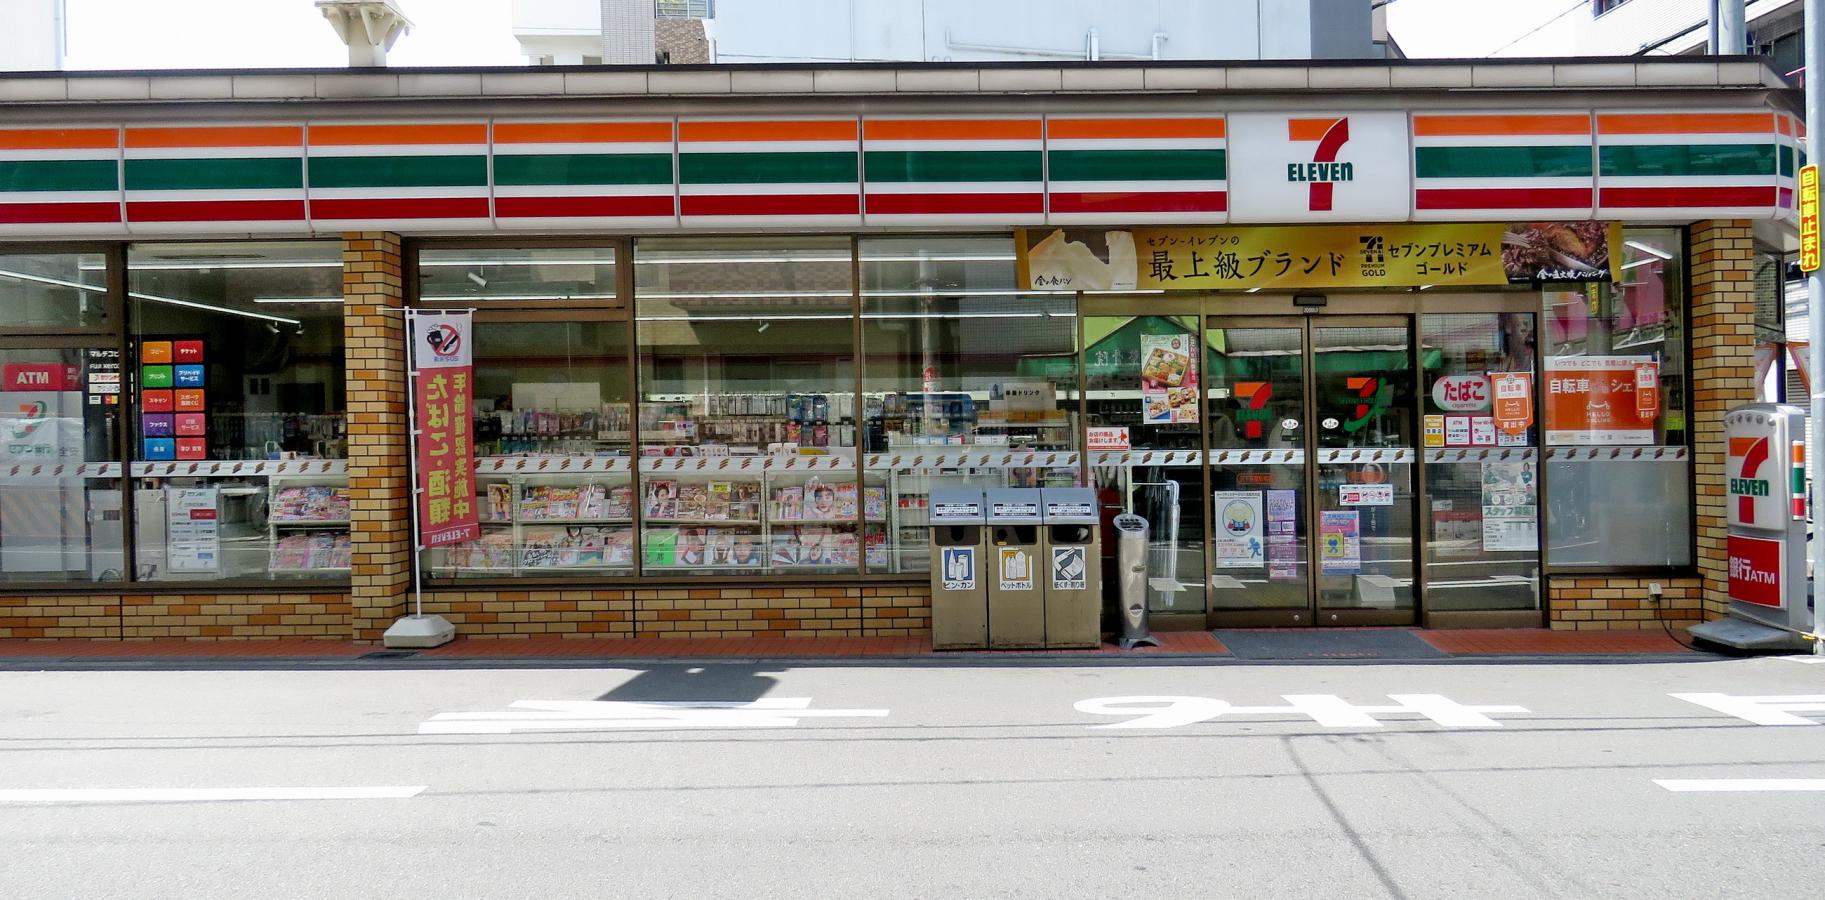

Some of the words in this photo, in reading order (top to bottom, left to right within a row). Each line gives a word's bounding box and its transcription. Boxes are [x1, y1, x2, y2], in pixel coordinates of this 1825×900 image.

[1801, 170, 1817, 268] 自転車止まれ
[1388, 242, 1492, 257] セブンプレミアム
[1148, 249, 1345, 282] 最上級ブランド
[1415, 262, 1467, 276] ゴールド
[1361, 269, 1386, 277] GOLD
[16, 371, 49, 384] ATM
[1443, 380, 1486, 402] たばこ
[1549, 377, 1590, 394] 自転車
[943, 581, 974, 589] ビン・カン
[1000, 581, 1032, 589] ペットボトル
